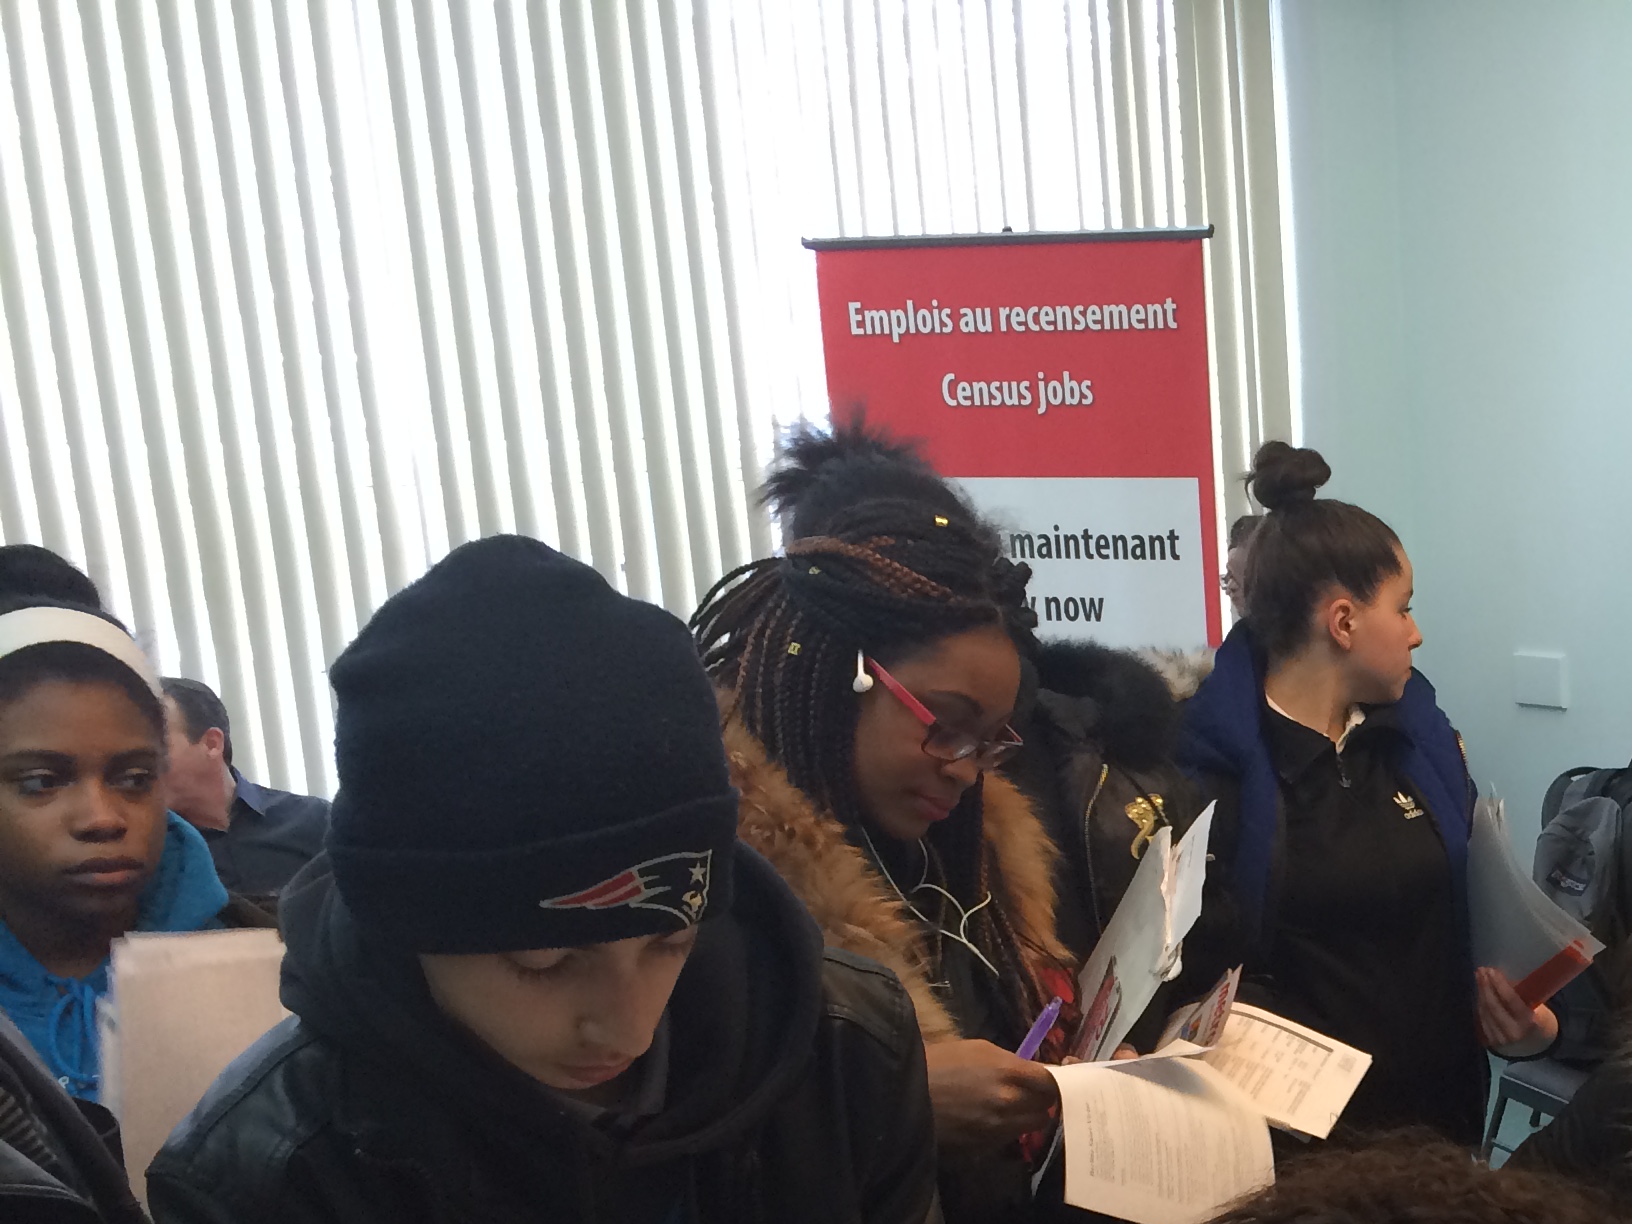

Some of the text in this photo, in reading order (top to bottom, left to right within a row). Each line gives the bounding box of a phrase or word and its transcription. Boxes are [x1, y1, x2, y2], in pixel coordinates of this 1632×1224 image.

[848, 297, 1177, 342] Emplois au recensement
[941, 371, 1093, 414] Census jobs
[1009, 525, 1181, 561] maintenant
[1044, 596, 1104, 622] now
